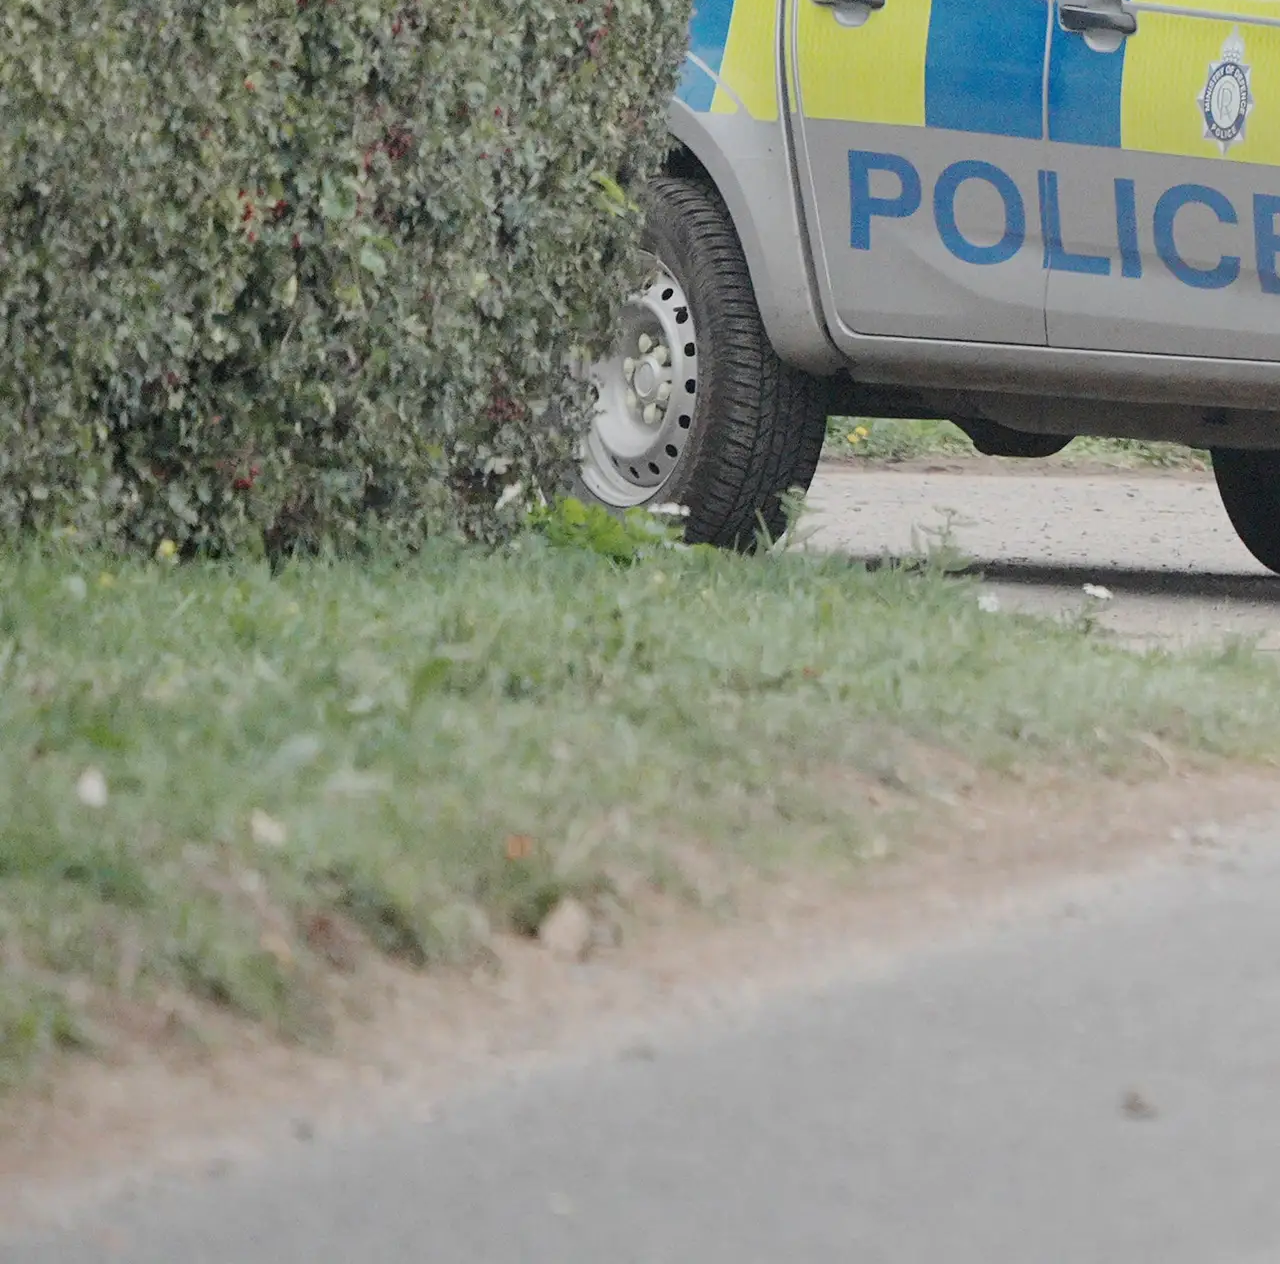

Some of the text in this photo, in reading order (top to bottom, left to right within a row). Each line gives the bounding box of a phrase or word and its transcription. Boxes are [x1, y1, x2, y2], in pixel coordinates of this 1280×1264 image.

[1205, 64, 1247, 115] MINISTRY OF DEFENCE
[1211, 123, 1237, 139] POLICE
